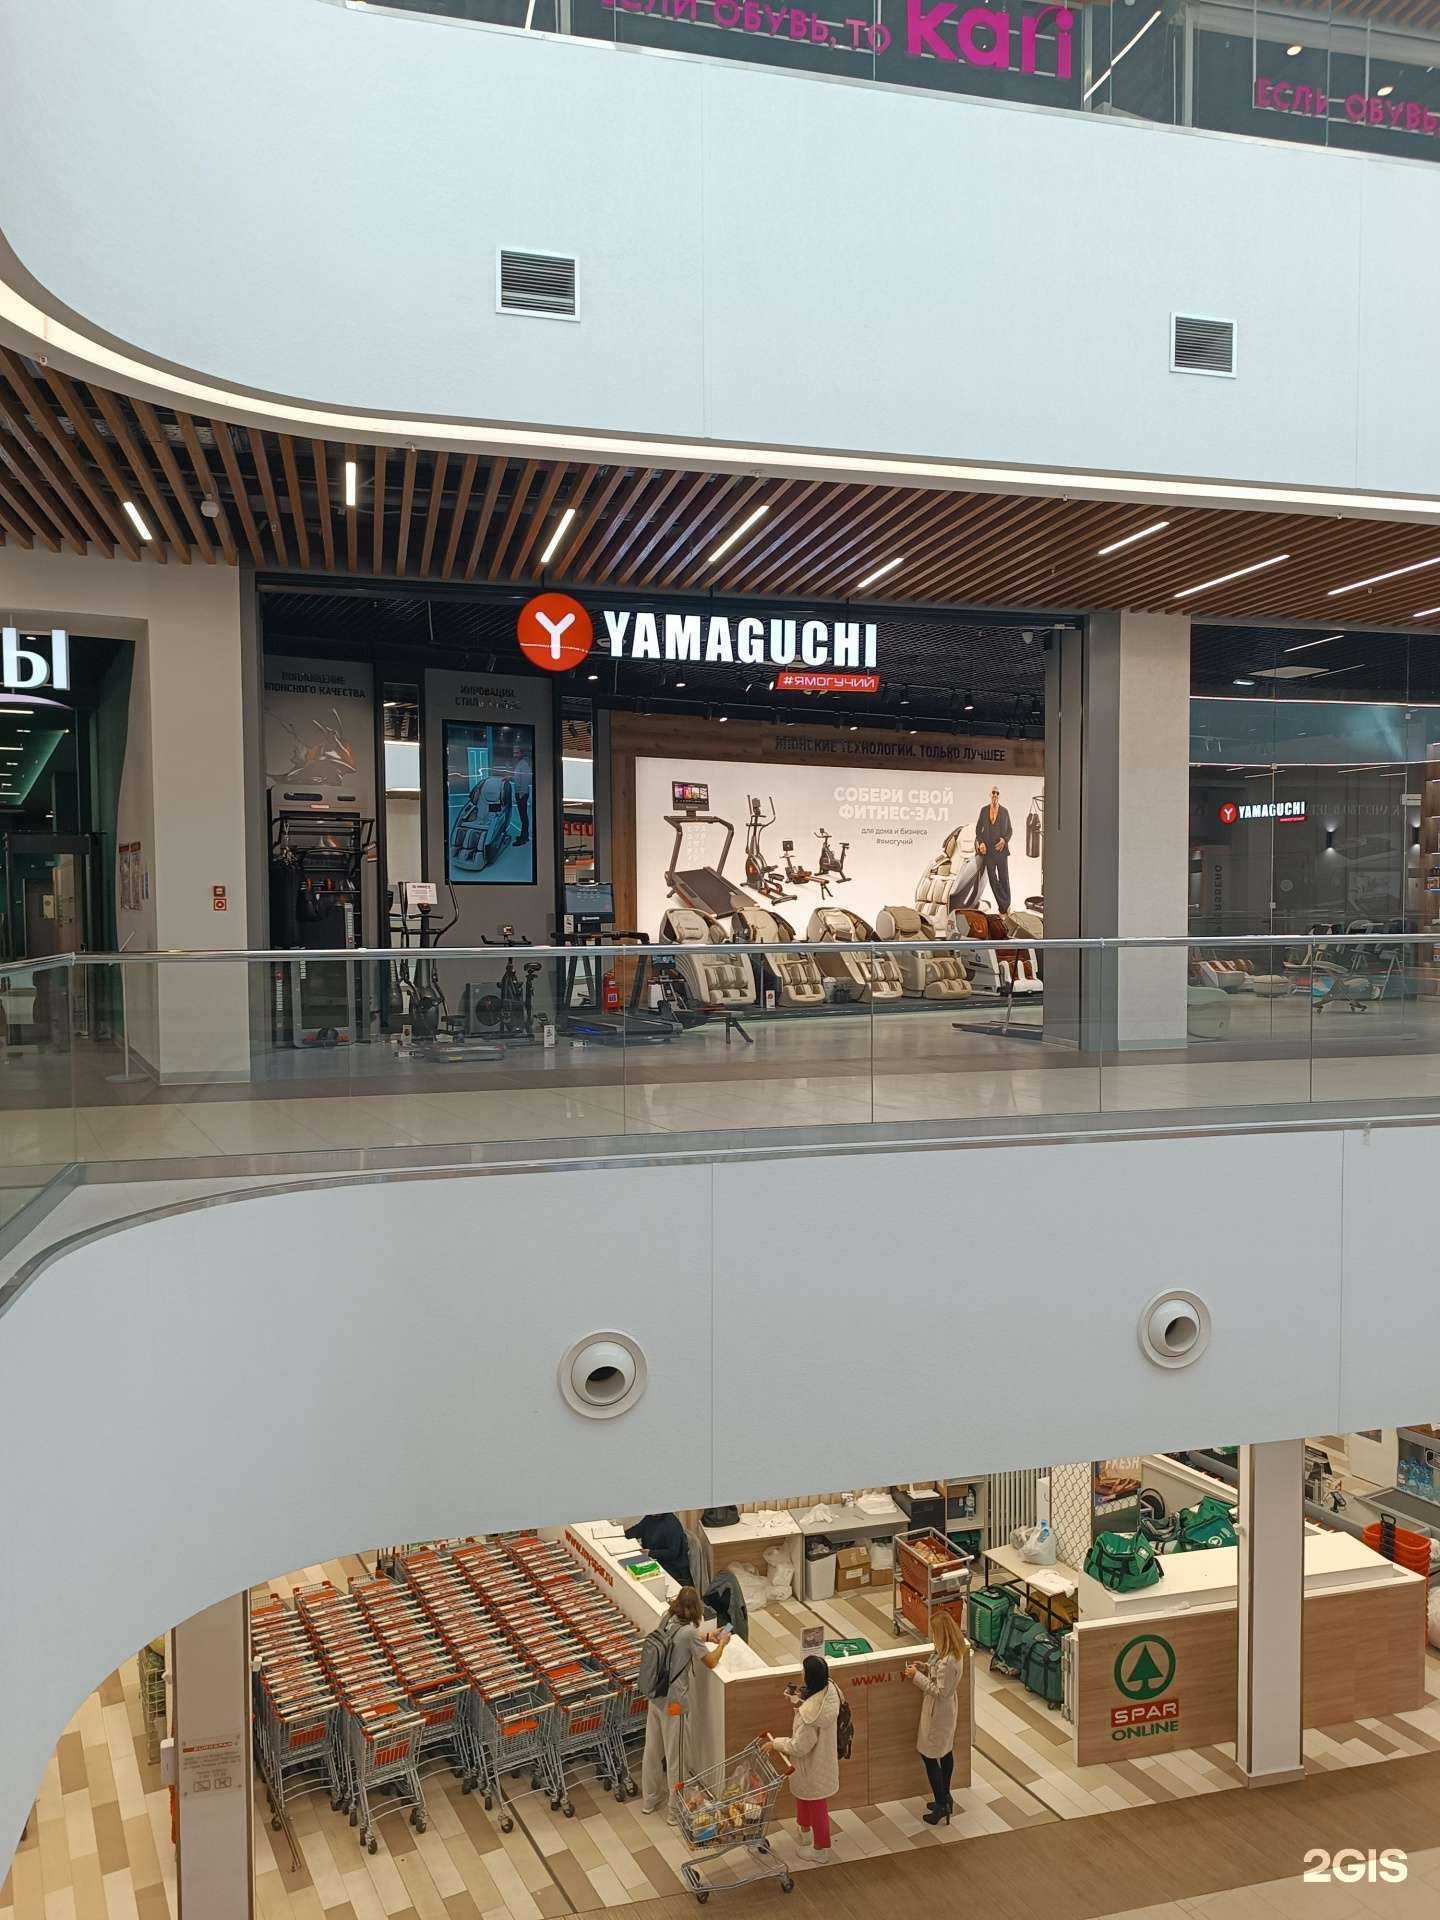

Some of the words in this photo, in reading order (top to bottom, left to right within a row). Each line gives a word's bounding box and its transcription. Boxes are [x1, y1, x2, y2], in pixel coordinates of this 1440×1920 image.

[714, 0, 838, 48] ОБУВЬ,
[845, 18, 892, 55] ТО
[905, 0, 1072, 80] kari
[603, 610, 877, 668] YAMAGUCHI
[783, 676, 875, 688] #ЯМОГУЧИЙ
[920, 745, 960, 760] ТОЛЬКО
[963, 748, 1006, 761] ЛУЧШЕЕ
[834, 786, 903, 803] СОБЕРИ
[908, 786, 954, 805] СВОЙ
[838, 804, 950, 821] ФИТНЕС-ЗАЛ
[1239, 801, 1306, 819] YAMAGUCHI
[1114, 1702, 1178, 1724] SPAR
[1112, 1720, 1179, 1741] ONLINE
